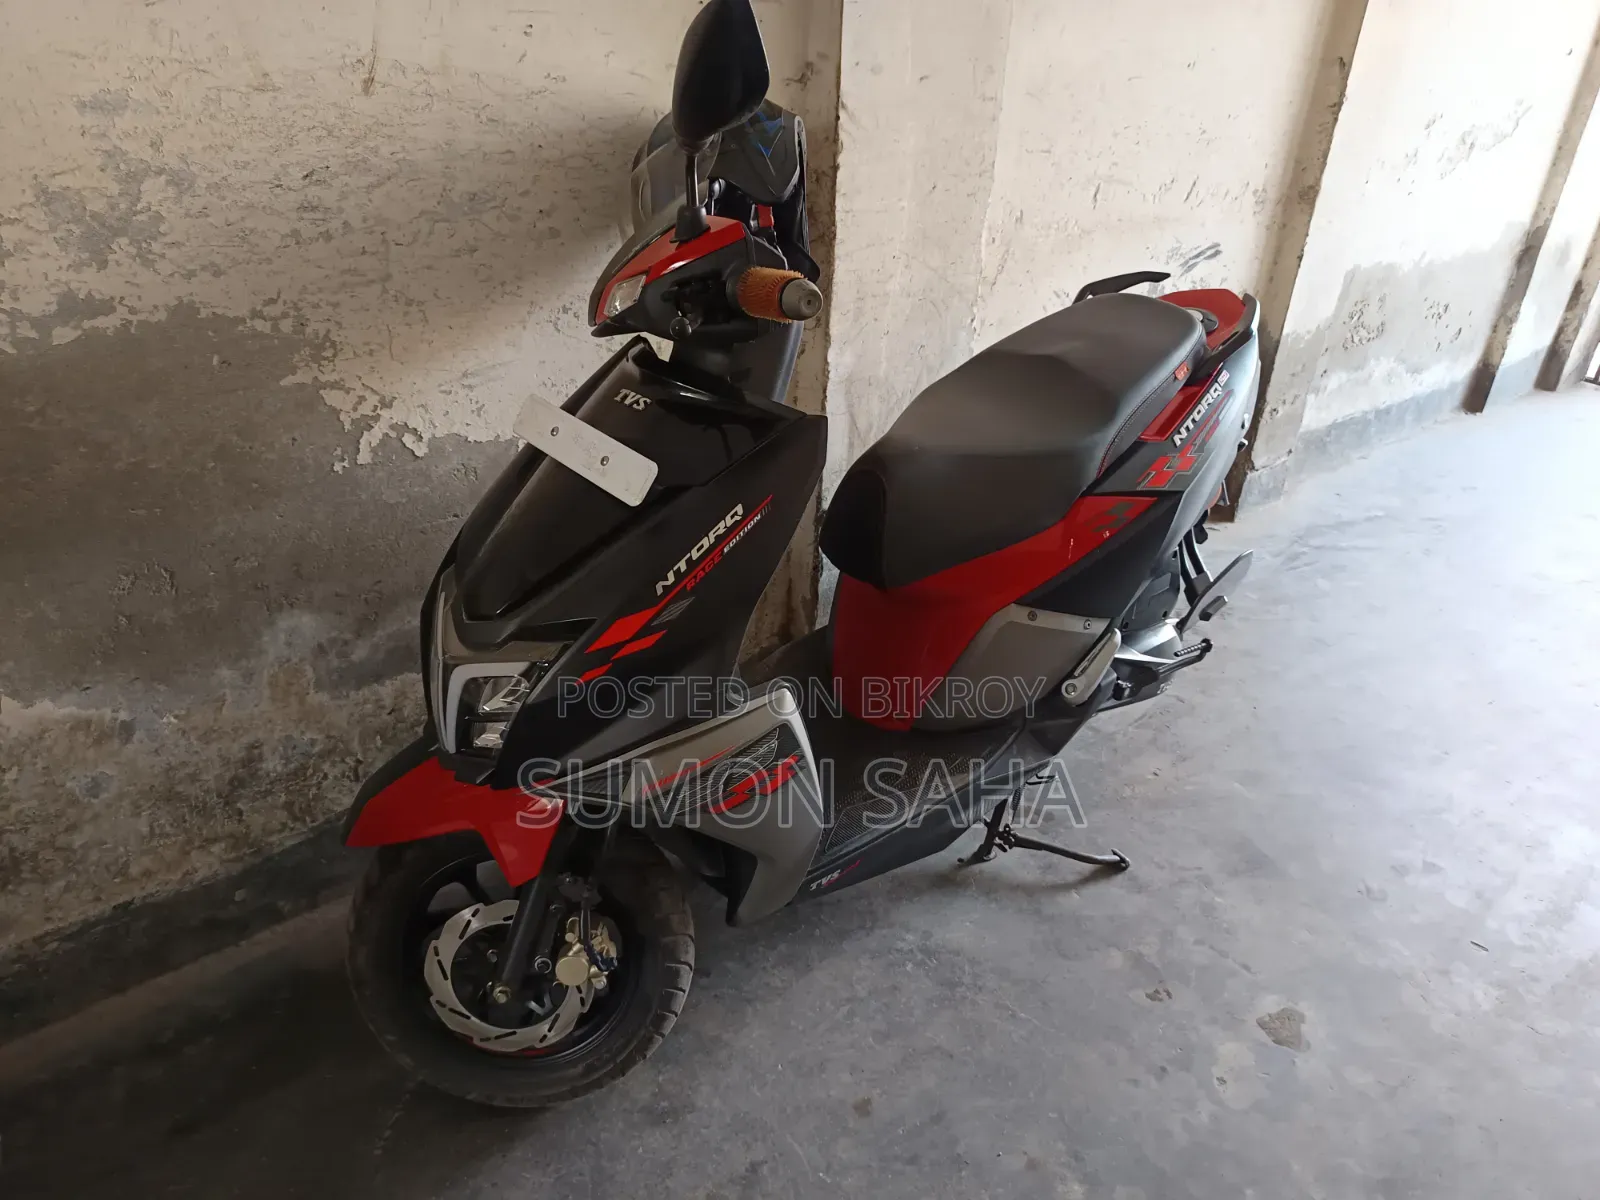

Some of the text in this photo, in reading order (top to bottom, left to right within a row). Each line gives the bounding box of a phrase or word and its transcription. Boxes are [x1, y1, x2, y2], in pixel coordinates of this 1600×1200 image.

[613, 388, 652, 411] TVS
[1173, 382, 1223, 448] NTORQ
[655, 503, 744, 597] NTORQ
[686, 513, 762, 592] RACE EDITION
[809, 868, 841, 891] TVS
